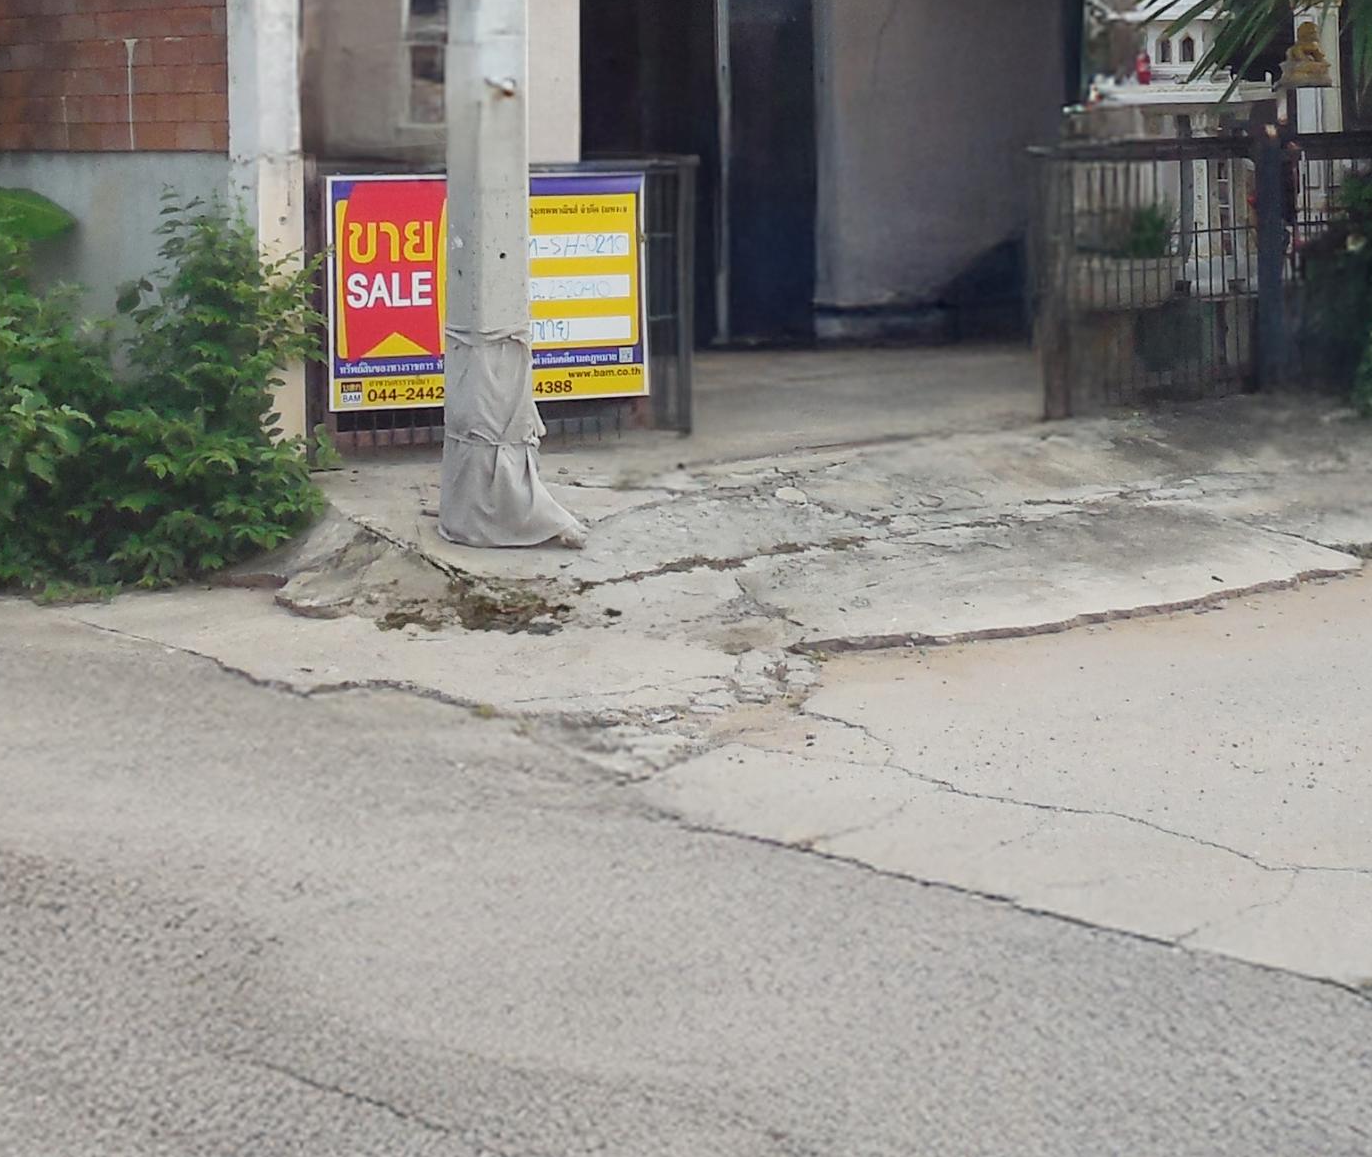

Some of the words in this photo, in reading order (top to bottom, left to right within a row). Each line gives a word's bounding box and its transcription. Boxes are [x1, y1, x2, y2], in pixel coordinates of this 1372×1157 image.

[348, 220, 434, 264] ขาย
[346, 271, 433, 309] SALE
[568, 366, 641, 378] www.bam.co.th
[367, 385, 445, 403] 044-2442
[532, 379, 573, 395] 4388
[342, 393, 362, 403] BAM
